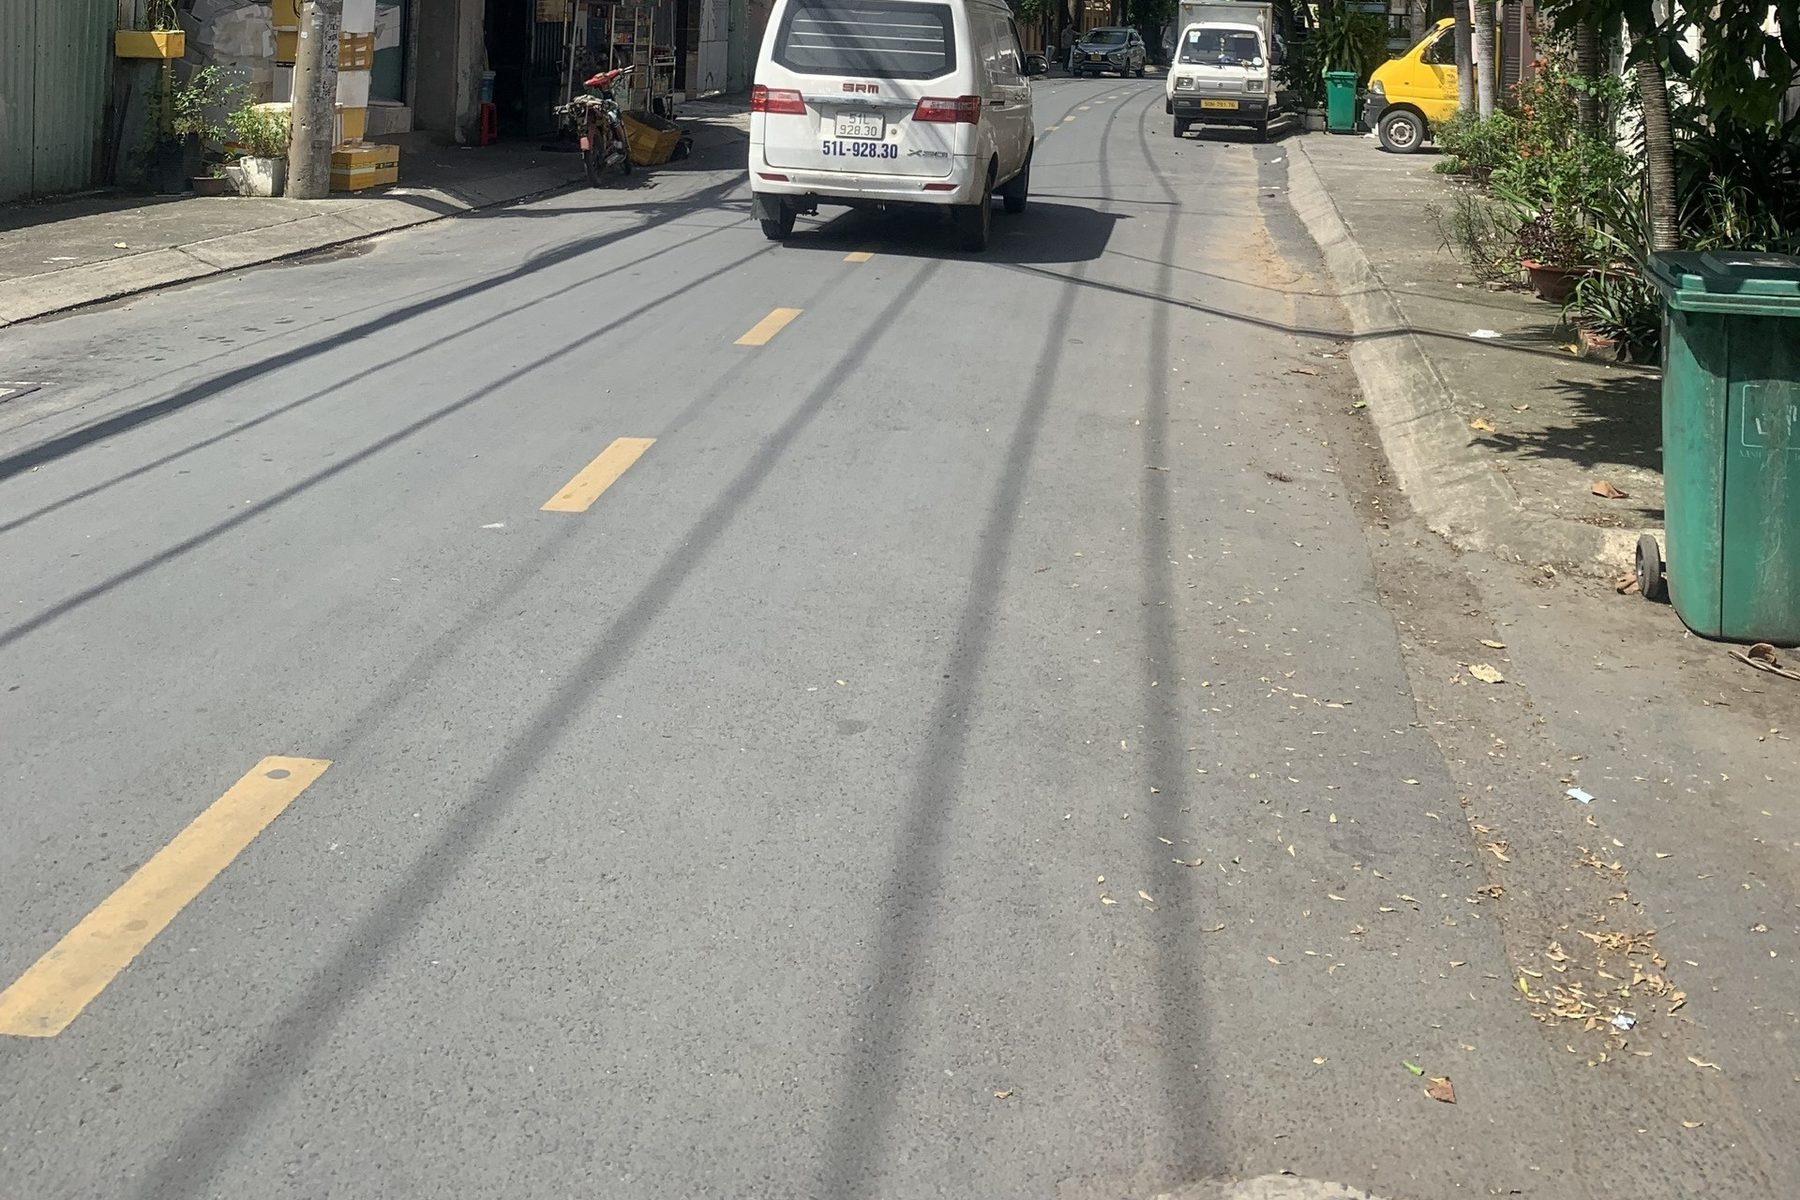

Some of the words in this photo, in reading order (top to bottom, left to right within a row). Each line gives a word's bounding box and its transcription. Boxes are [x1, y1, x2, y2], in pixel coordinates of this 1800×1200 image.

[842, 83, 879, 94] SRM
[849, 114, 870, 125] 51L
[840, 125, 877, 136] 928.30
[822, 140, 898, 159] 51L-928.30
